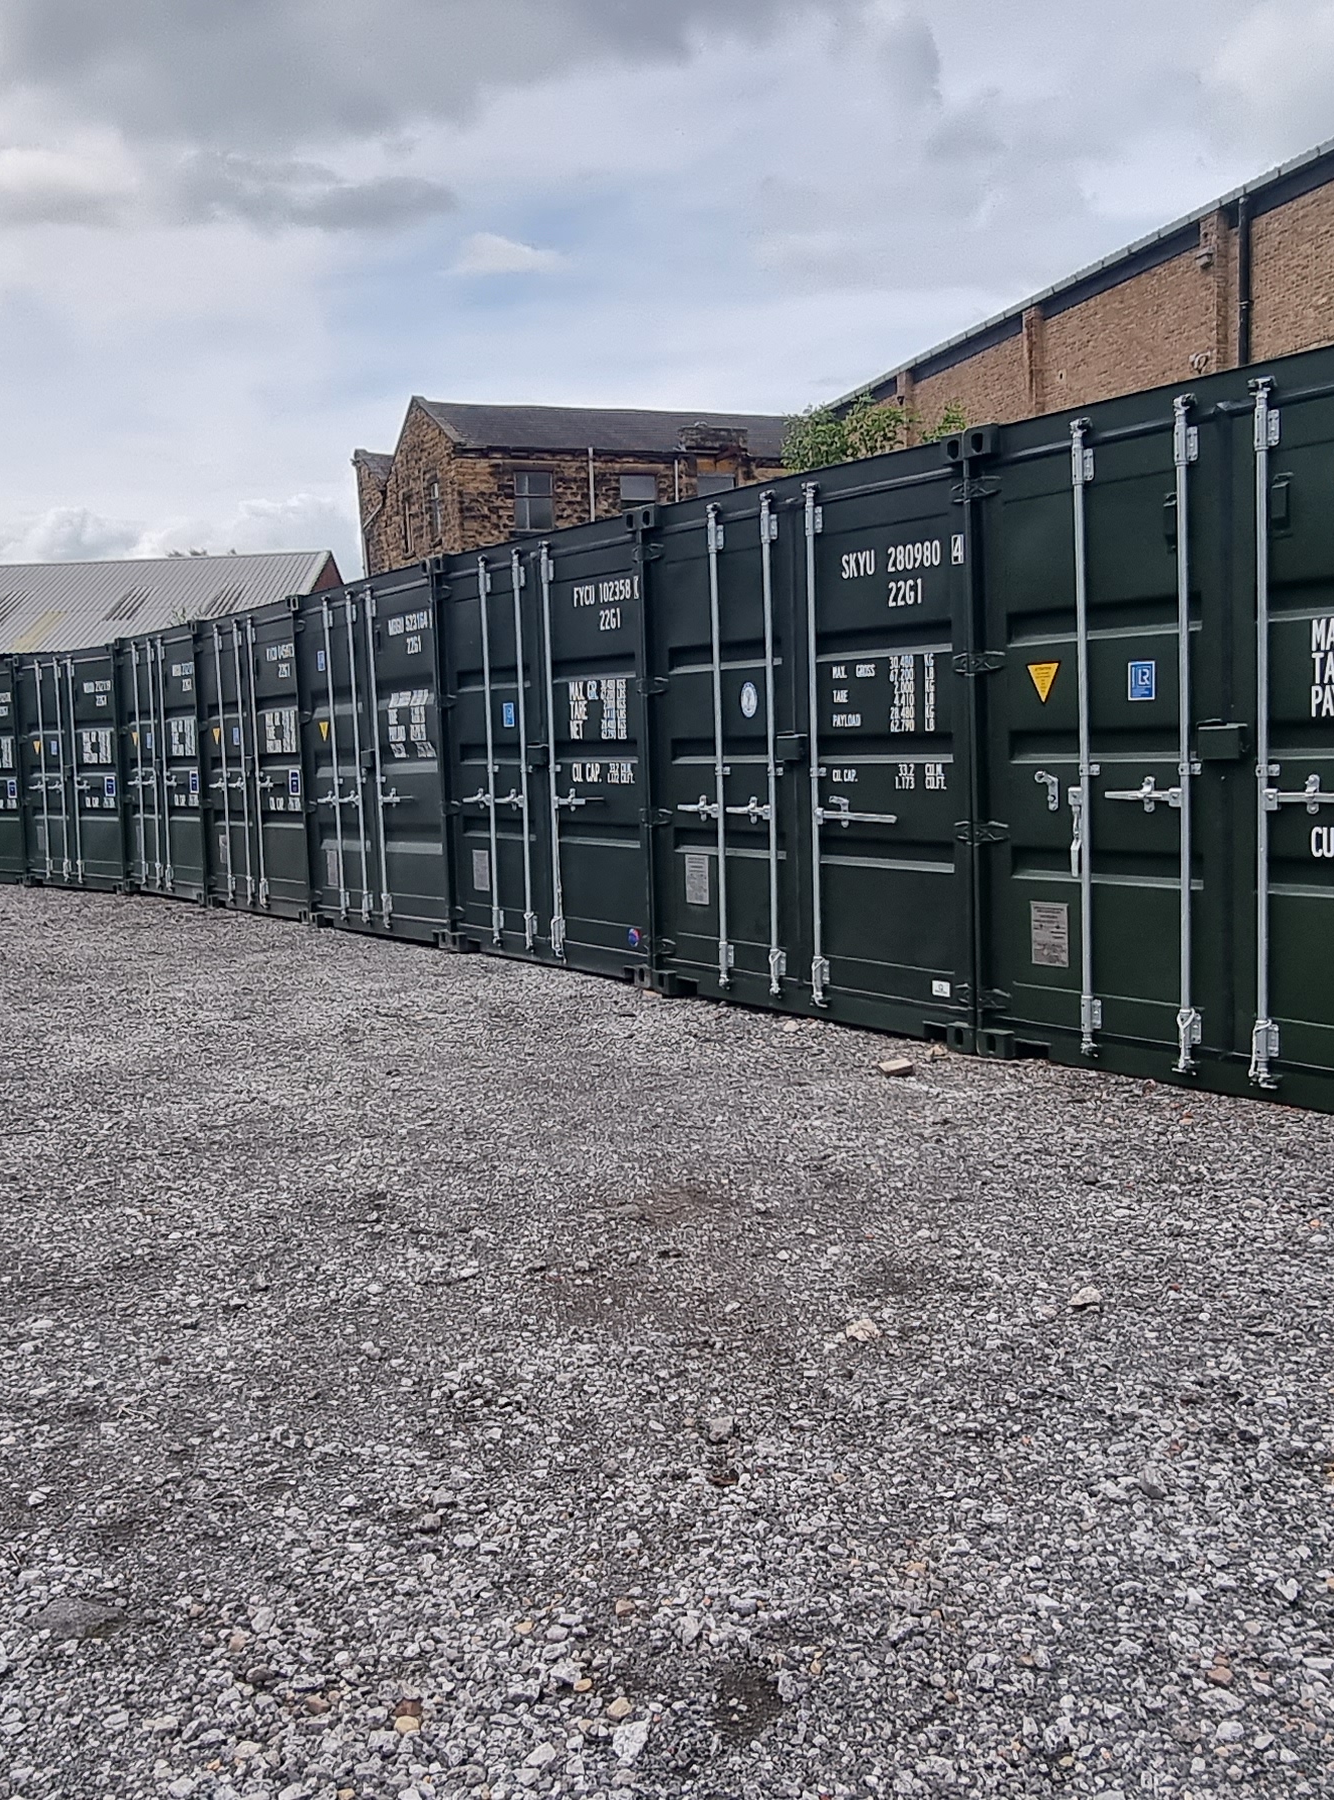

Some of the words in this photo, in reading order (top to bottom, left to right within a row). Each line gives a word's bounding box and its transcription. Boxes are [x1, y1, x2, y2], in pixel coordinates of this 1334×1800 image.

[841, 548, 876, 580] SKYU
[886, 538, 941, 574] 280980
[951, 534, 964, 565] 4
[599, 579, 631, 604] 102358
[887, 577, 923, 608] 22G1
[599, 608, 621, 631] 22G1
[893, 693, 914, 706] 4.410
[569, 700, 588, 720] TARE
[569, 720, 584, 740] NET
[832, 714, 862, 728] PAYLOAD
[890, 719, 914, 732] 62.790
[898, 764, 914, 776] 33.2
[895, 776, 915, 789] 1.173
